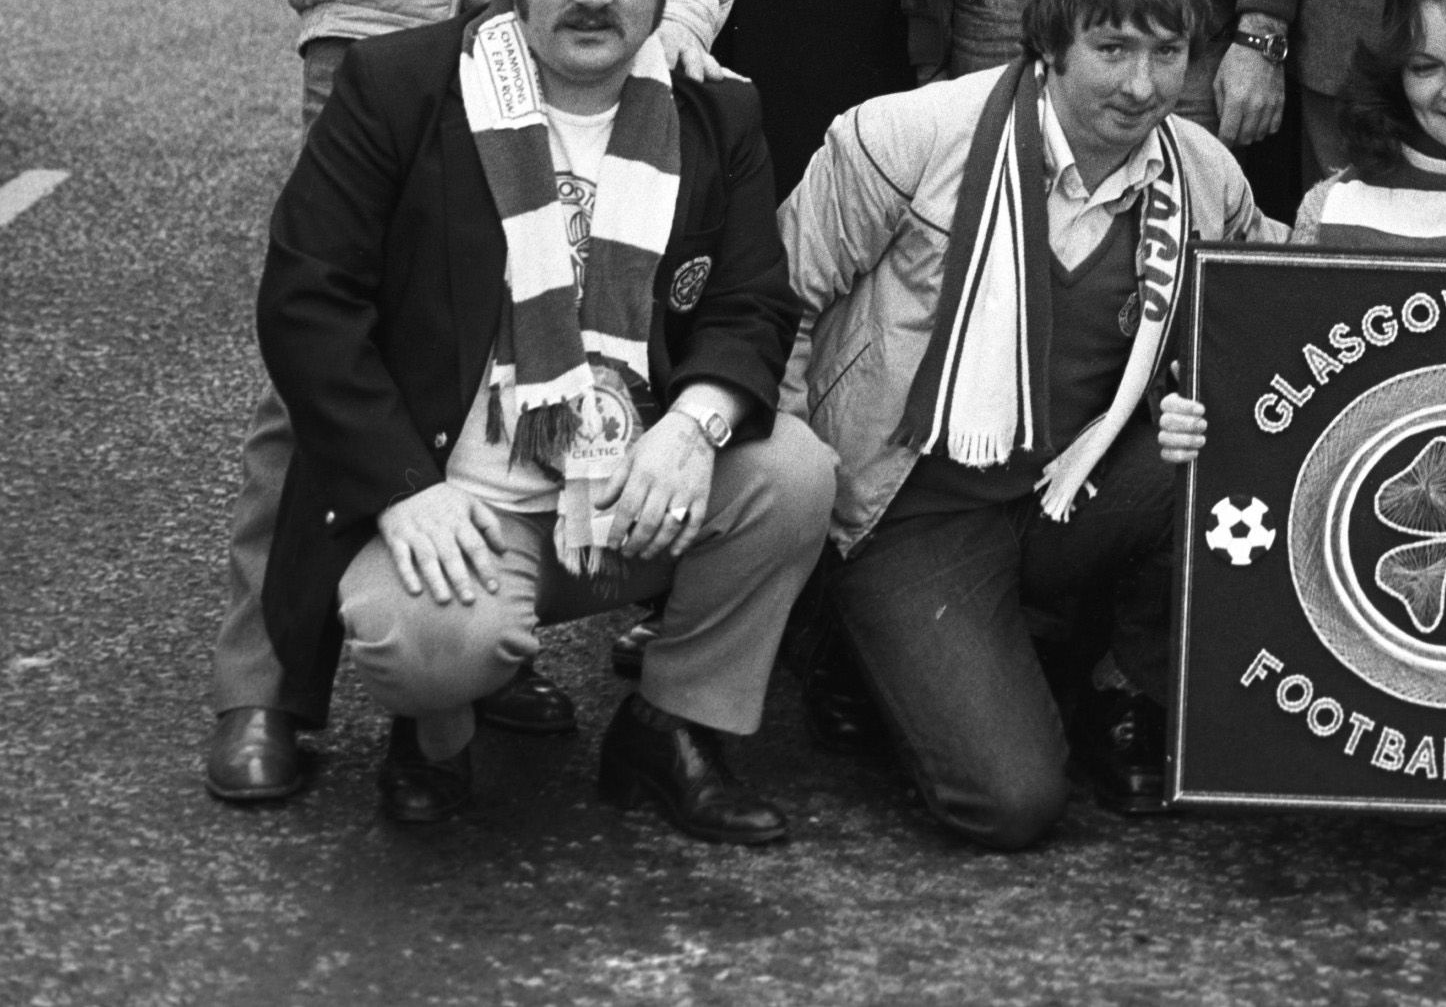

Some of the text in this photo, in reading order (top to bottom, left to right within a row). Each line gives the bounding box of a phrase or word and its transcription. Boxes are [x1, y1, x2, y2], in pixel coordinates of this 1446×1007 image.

[501, 31, 527, 105] CHAMPIONS
[502, 85, 515, 114] ROW
[572, 447, 619, 460] CELTIC
